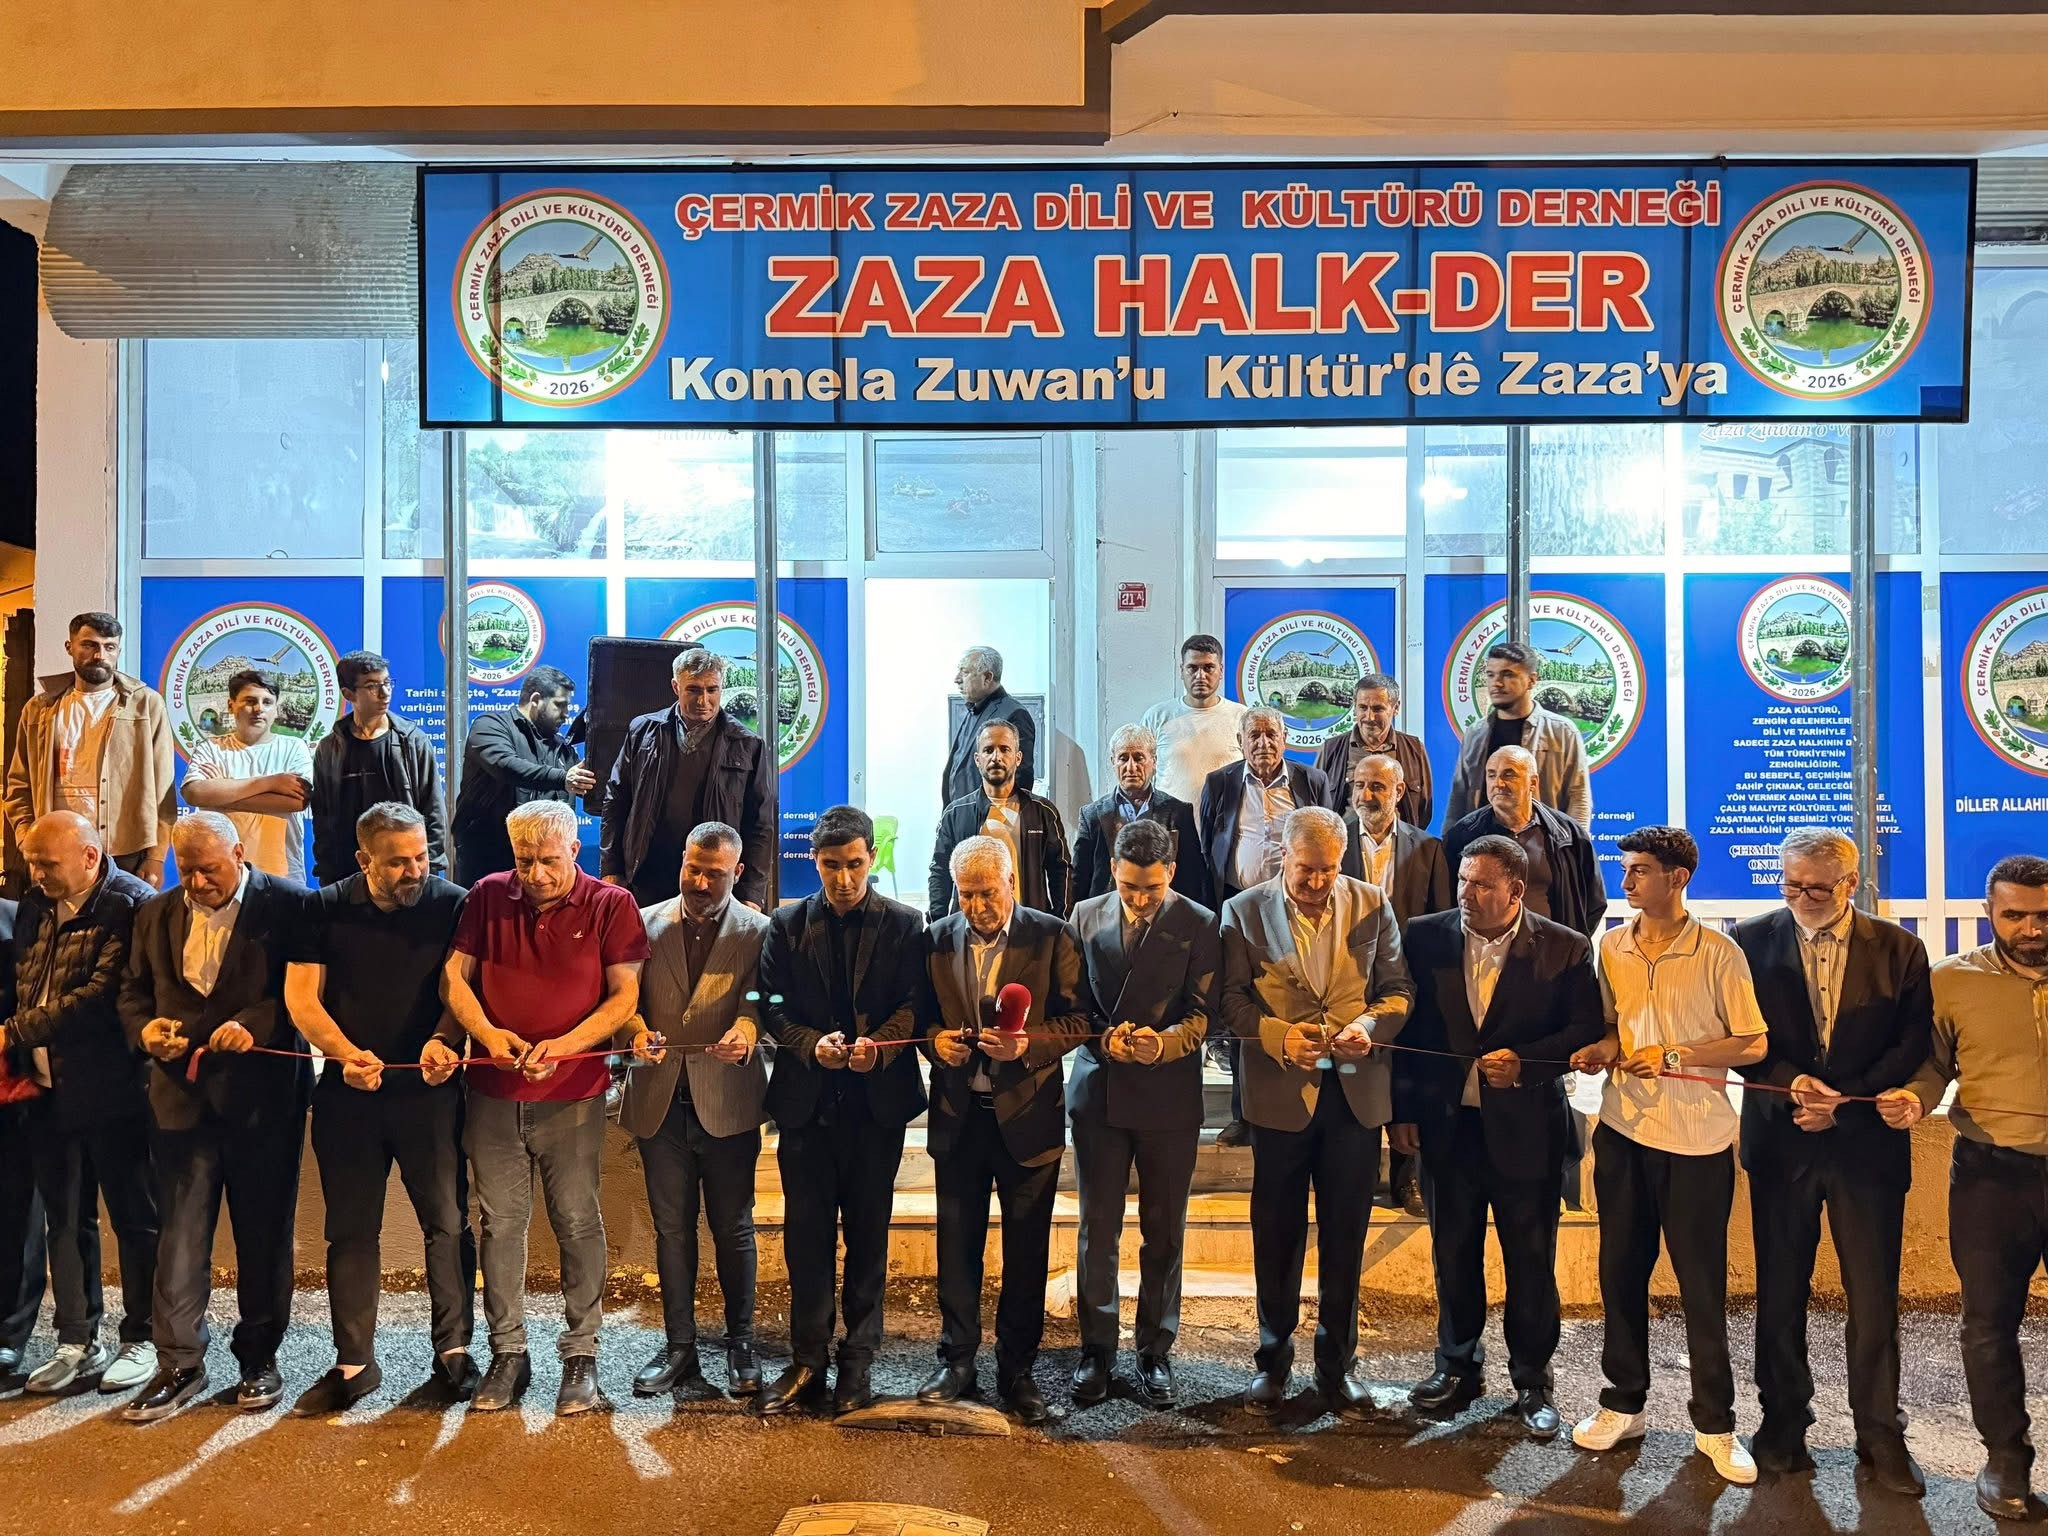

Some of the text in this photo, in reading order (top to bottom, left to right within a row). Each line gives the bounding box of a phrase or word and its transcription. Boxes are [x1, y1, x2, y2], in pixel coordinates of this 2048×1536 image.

[675, 180, 1721, 240] ÇERMİK ZAZA DİLİ VE KÜLTÜRÜ DERNEĞİ
[1731, 196, 1921, 313] ÇERMİK ZAZA DİLİ VE KÜLTÜRÜ DERNEĞİ
[469, 203, 659, 321] ÇERMİK ZAZA DİLİ VE KÜLTÜRÜ DERNEĞİ
[765, 250, 1655, 338] ZAZA HALK-DER
[669, 357, 896, 402] Komela
[1807, 373, 1847, 389] 2026
[549, 379, 590, 395] 2026
[1121, 593, 1135, 606] 21
[1977, 598, 2046, 697] ÇERMİK ZAZA DİLİ
[693, 617, 717, 634] DİLİ
[721, 614, 737, 623] VE
[795, 649, 818, 703] DERNEĞİ
[1247, 619, 1372, 692] ÇERMİK ZAZA DİLİ VE KÜLTÜRÜ DERN
[1458, 651, 1475, 703] ÇERMİK
[1471, 621, 1501, 650] ZAZA
[1533, 605, 1551, 614] VE
[1611, 644, 1635, 703] DERNEĞİ
[173, 614, 336, 711] ÇERMİK ZAZA DİLİ VE KÜLTÜRÜ DERNEĞİ
[481, 672, 502, 681] 2026
[1791, 688, 1816, 697] 2026
[1767, 705, 1841, 715] ZAZA KÜLTÜRÜ,
[1752, 716, 1788, 725] ZENGİN
[1763, 727, 1846, 736] DİLİ VE TARİHİYLE
[1295, 735, 1322, 745] 2026
[1733, 739, 1770, 747] SADECE
[1771, 739, 1797, 747] ZAZA
[1798, 739, 1843, 747] HALKININ
[1763, 749, 1784, 758] TÜM
[1744, 771, 1758, 780] BU
[1759, 771, 1803, 781] SEBEPLE,
[1735, 781, 1763, 790] SAHİP
[1765, 782, 1805, 791] ÇIKMAK,
[1726, 792, 1746, 801] YÖN
[1748, 793, 1787, 801] VERMEK
[1788, 793, 1817, 801] ADINA
[1819, 793, 1831, 801] EL
[1719, 804, 1747, 813] ÇALIŞ
[1749, 804, 1787, 812] MALIYIZ
[1789, 803, 1838, 812] KÜLTÜREL
[1955, 795, 1999, 813] DİLLER
[1714, 815, 1764, 824] YAŞATMAK
[1766, 814, 1786, 824] İÇİN
[1788, 814, 1828, 823] SESİMİZİ
[1709, 826, 1734, 834] ZAZA
[1736, 825, 1782, 834] KİMLİĞİNİ
